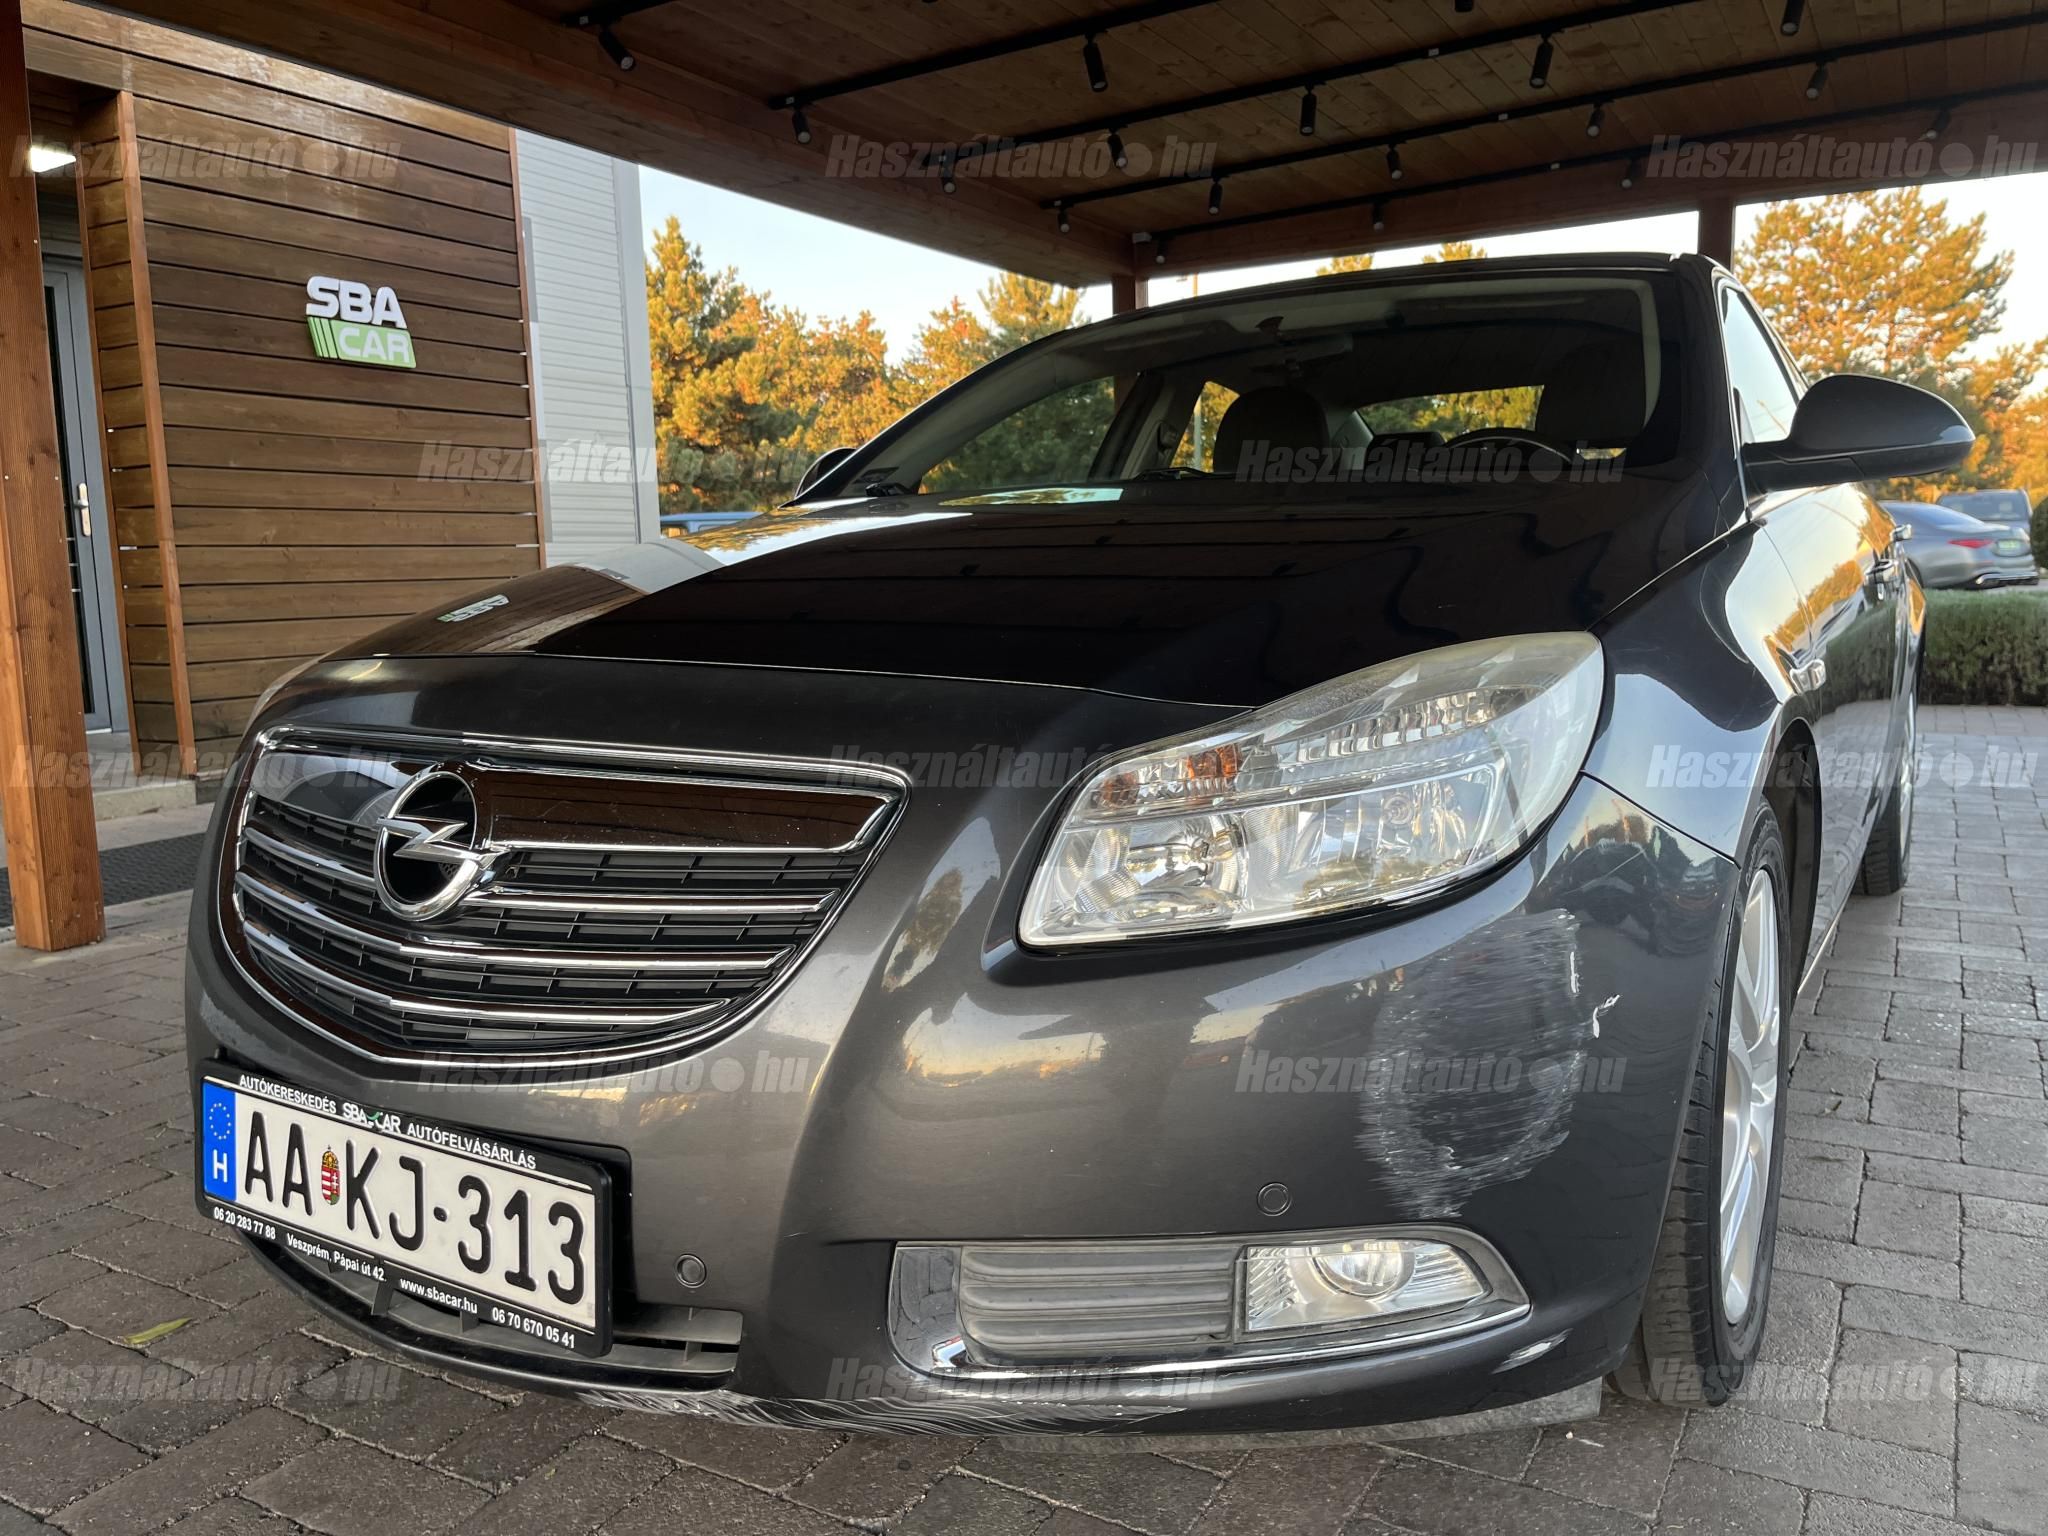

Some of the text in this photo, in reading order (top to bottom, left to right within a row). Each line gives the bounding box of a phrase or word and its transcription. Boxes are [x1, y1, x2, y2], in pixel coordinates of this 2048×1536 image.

[306, 276, 408, 329] SBA
[339, 327, 410, 363] CAR
[239, 1074, 337, 1114] AUTÓKERESKEDÉS
[407, 1123, 537, 1170] AUTÓFELVÁSÁRLÁS
[213, 1149, 229, 1183] H
[244, 1111, 314, 1216] AA
[213, 1207, 225, 1221] 06
[225, 1210, 236, 1225] 20
[237, 1214, 252, 1231] 283
[253, 1220, 263, 1235] 77
[265, 1225, 276, 1240] 88
[287, 1233, 332, 1262] Veszprém,
[334, 1250, 359, 1272] Pápai
[361, 1261, 371, 1277] út
[400, 1278, 478, 1314] www.sbacar.hu
[492, 1306, 506, 1324] 06
[507, 1312, 521, 1329] 70
[523, 1318, 543, 1337] 670
[545, 1325, 559, 1342] 05
[561, 1331, 575, 1349] 41
